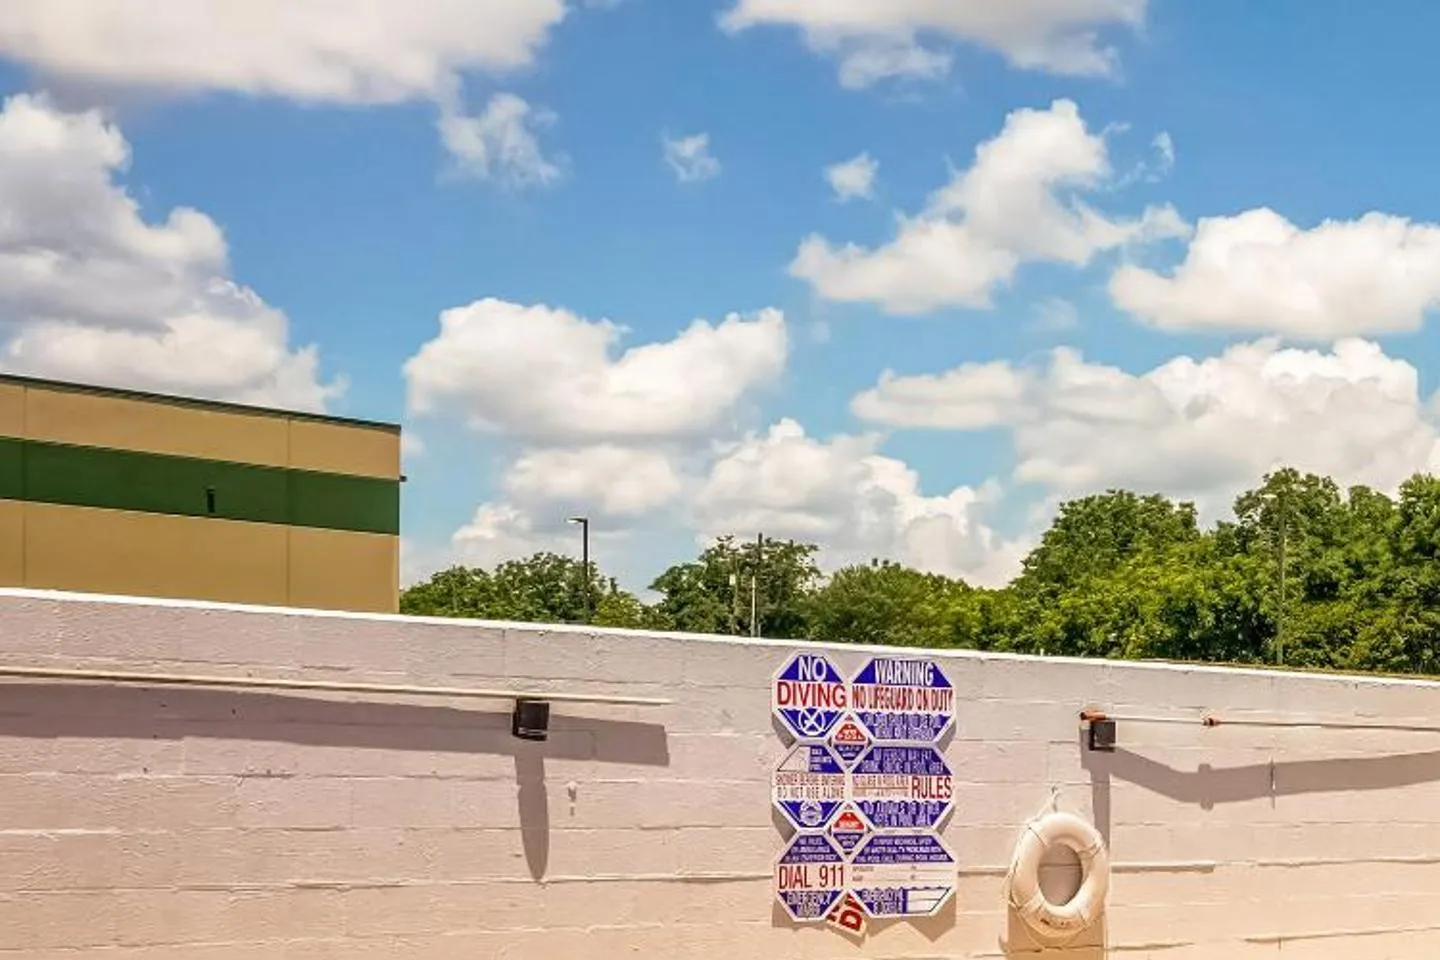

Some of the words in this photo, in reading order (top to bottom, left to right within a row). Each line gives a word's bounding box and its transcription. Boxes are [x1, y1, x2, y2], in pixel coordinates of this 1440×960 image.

[798, 656, 827, 681] NO
[875, 659, 934, 687] WARNING
[777, 681, 847, 708] DIVING
[852, 684, 866, 709] NO
[869, 685, 914, 711] LIFEGUARD
[912, 776, 951, 798] RULES
[779, 866, 812, 889] DIAL
[820, 865, 844, 888] 911
